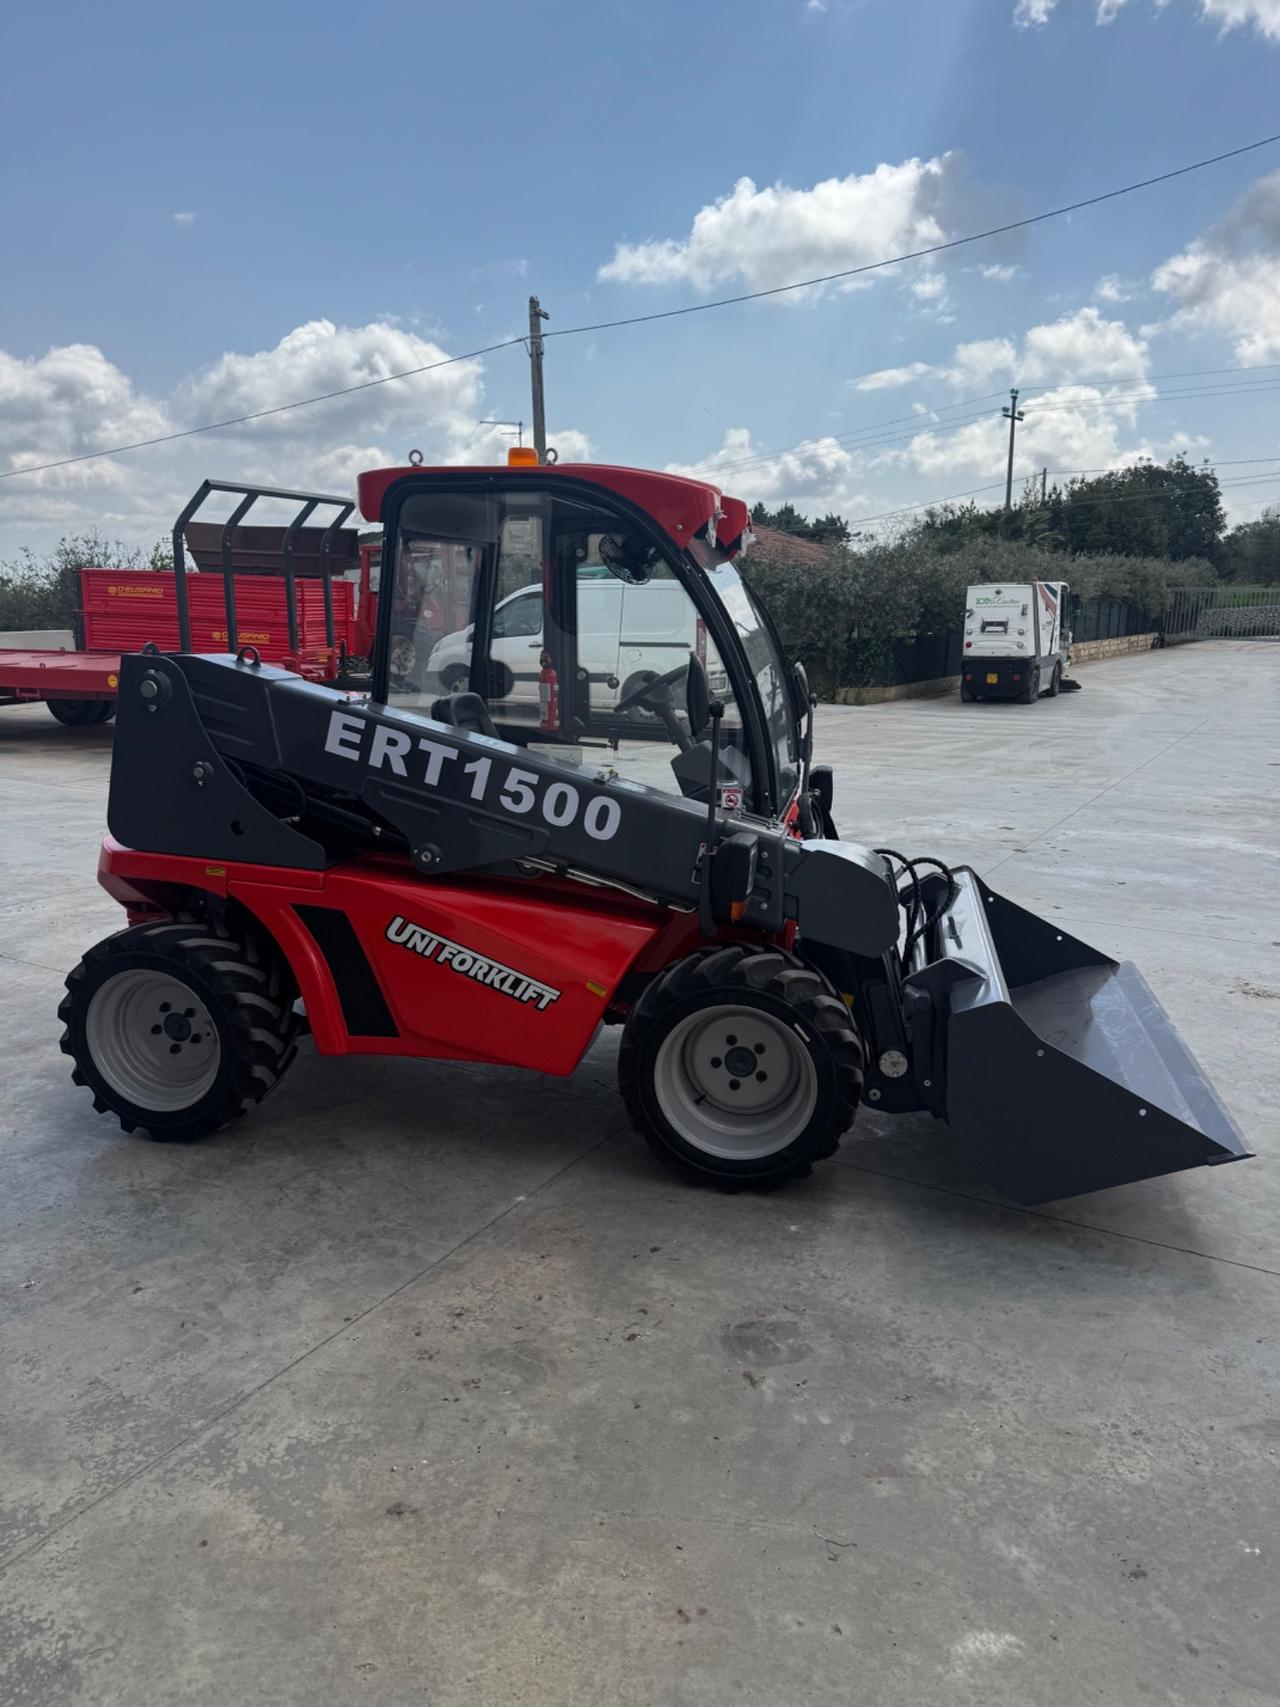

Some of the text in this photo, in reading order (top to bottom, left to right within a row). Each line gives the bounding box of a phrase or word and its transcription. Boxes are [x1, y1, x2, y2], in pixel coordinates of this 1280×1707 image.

[324, 710, 622, 841] ERT1500
[386, 916, 561, 1009] UNI FORKLIFT
